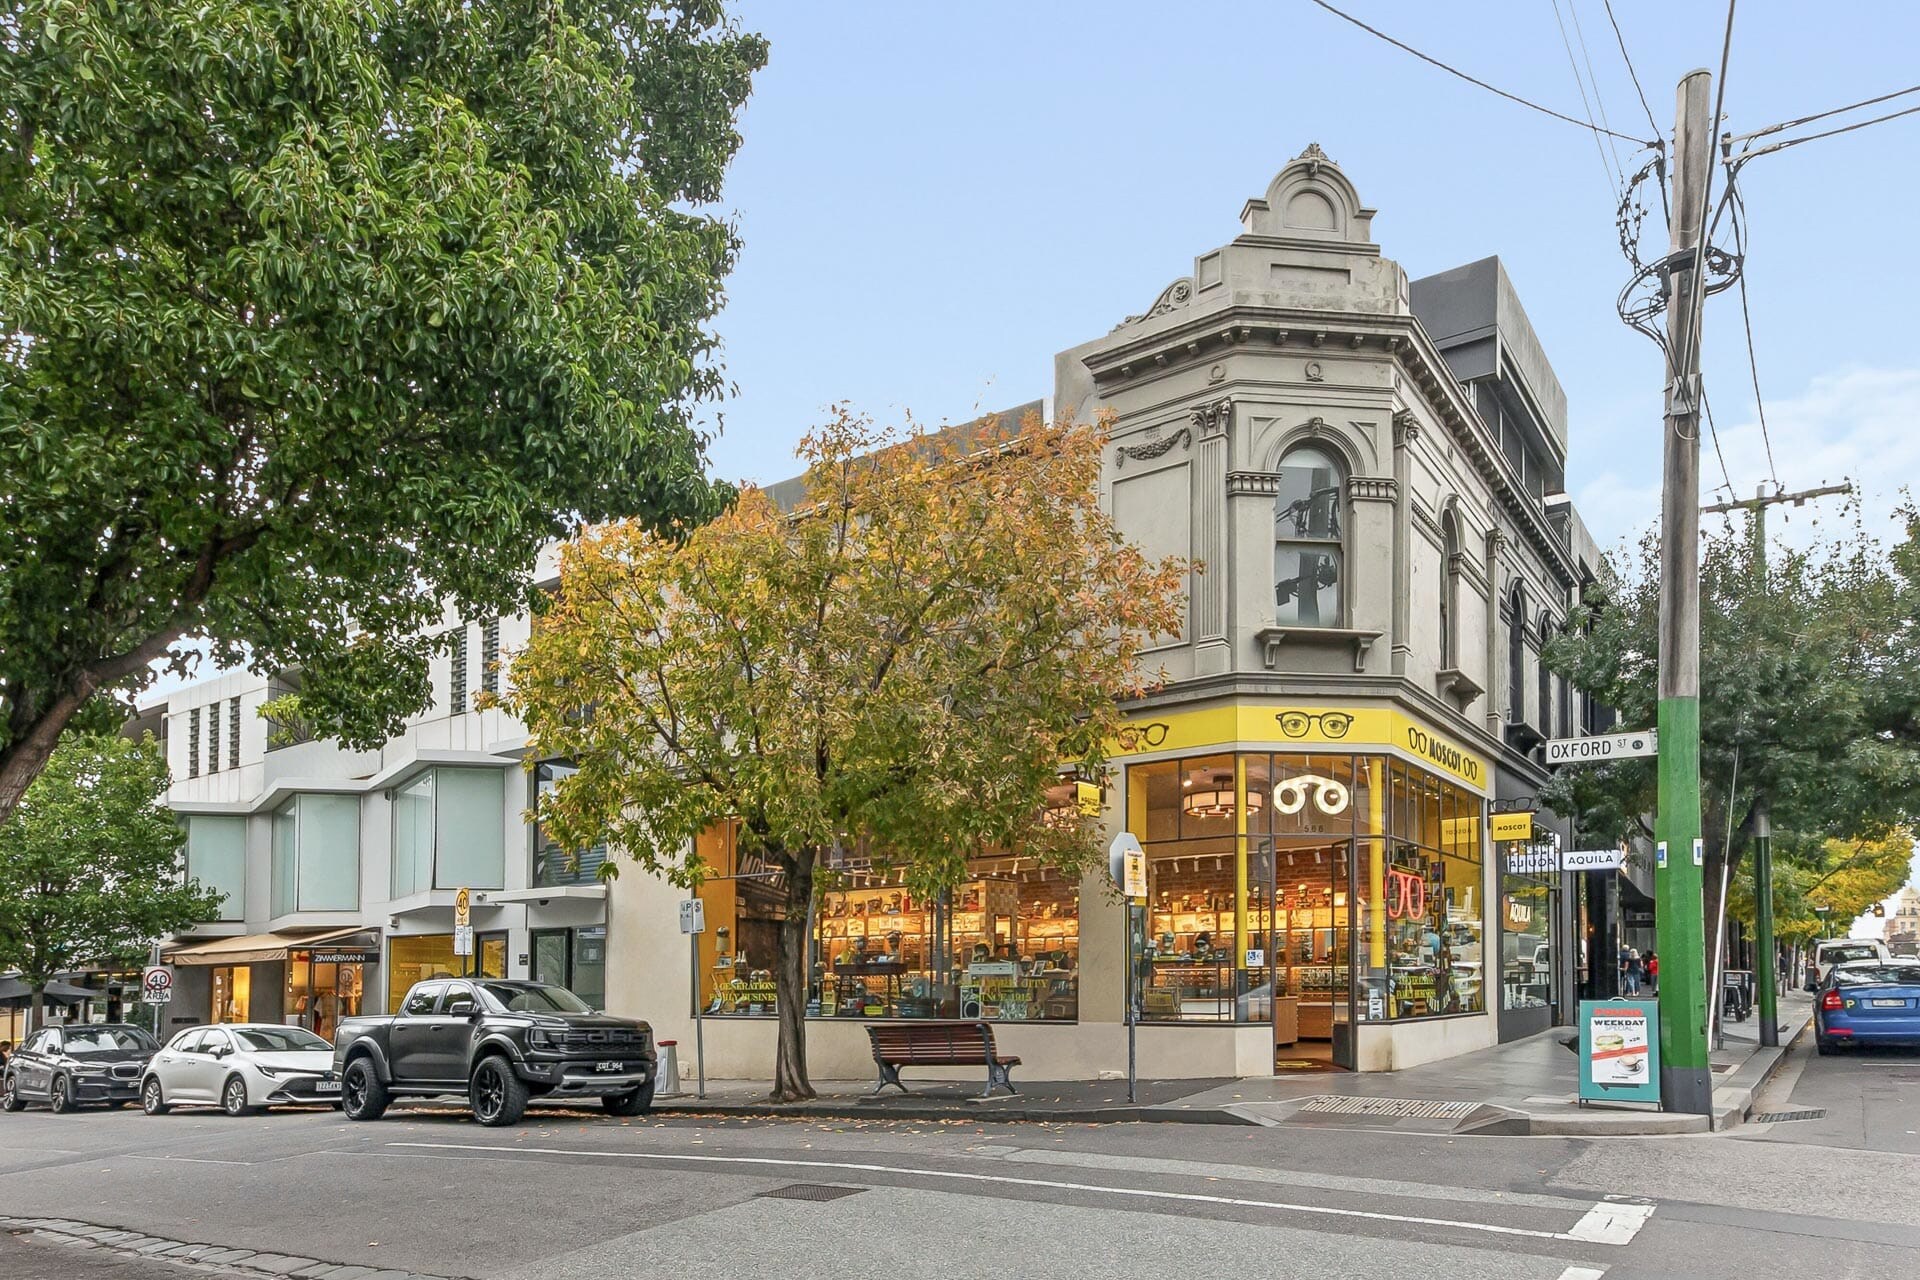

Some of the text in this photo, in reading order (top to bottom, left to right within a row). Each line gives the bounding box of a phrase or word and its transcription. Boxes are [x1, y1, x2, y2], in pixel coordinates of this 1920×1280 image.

[1551, 740, 1611, 759] OXFORD
[1617, 738, 1627, 748] ST
[1429, 737, 1461, 773] MOSCOT
[1497, 824, 1527, 832] MOSCOT
[1568, 854, 1614, 865] AQUILA
[314, 954, 366, 962] ZIMMERMANN
[150, 974, 167, 984] 40
[145, 991, 170, 1000] AREA
[1846, 1000, 1855, 1008] P
[563, 1031, 647, 1043] FORD
